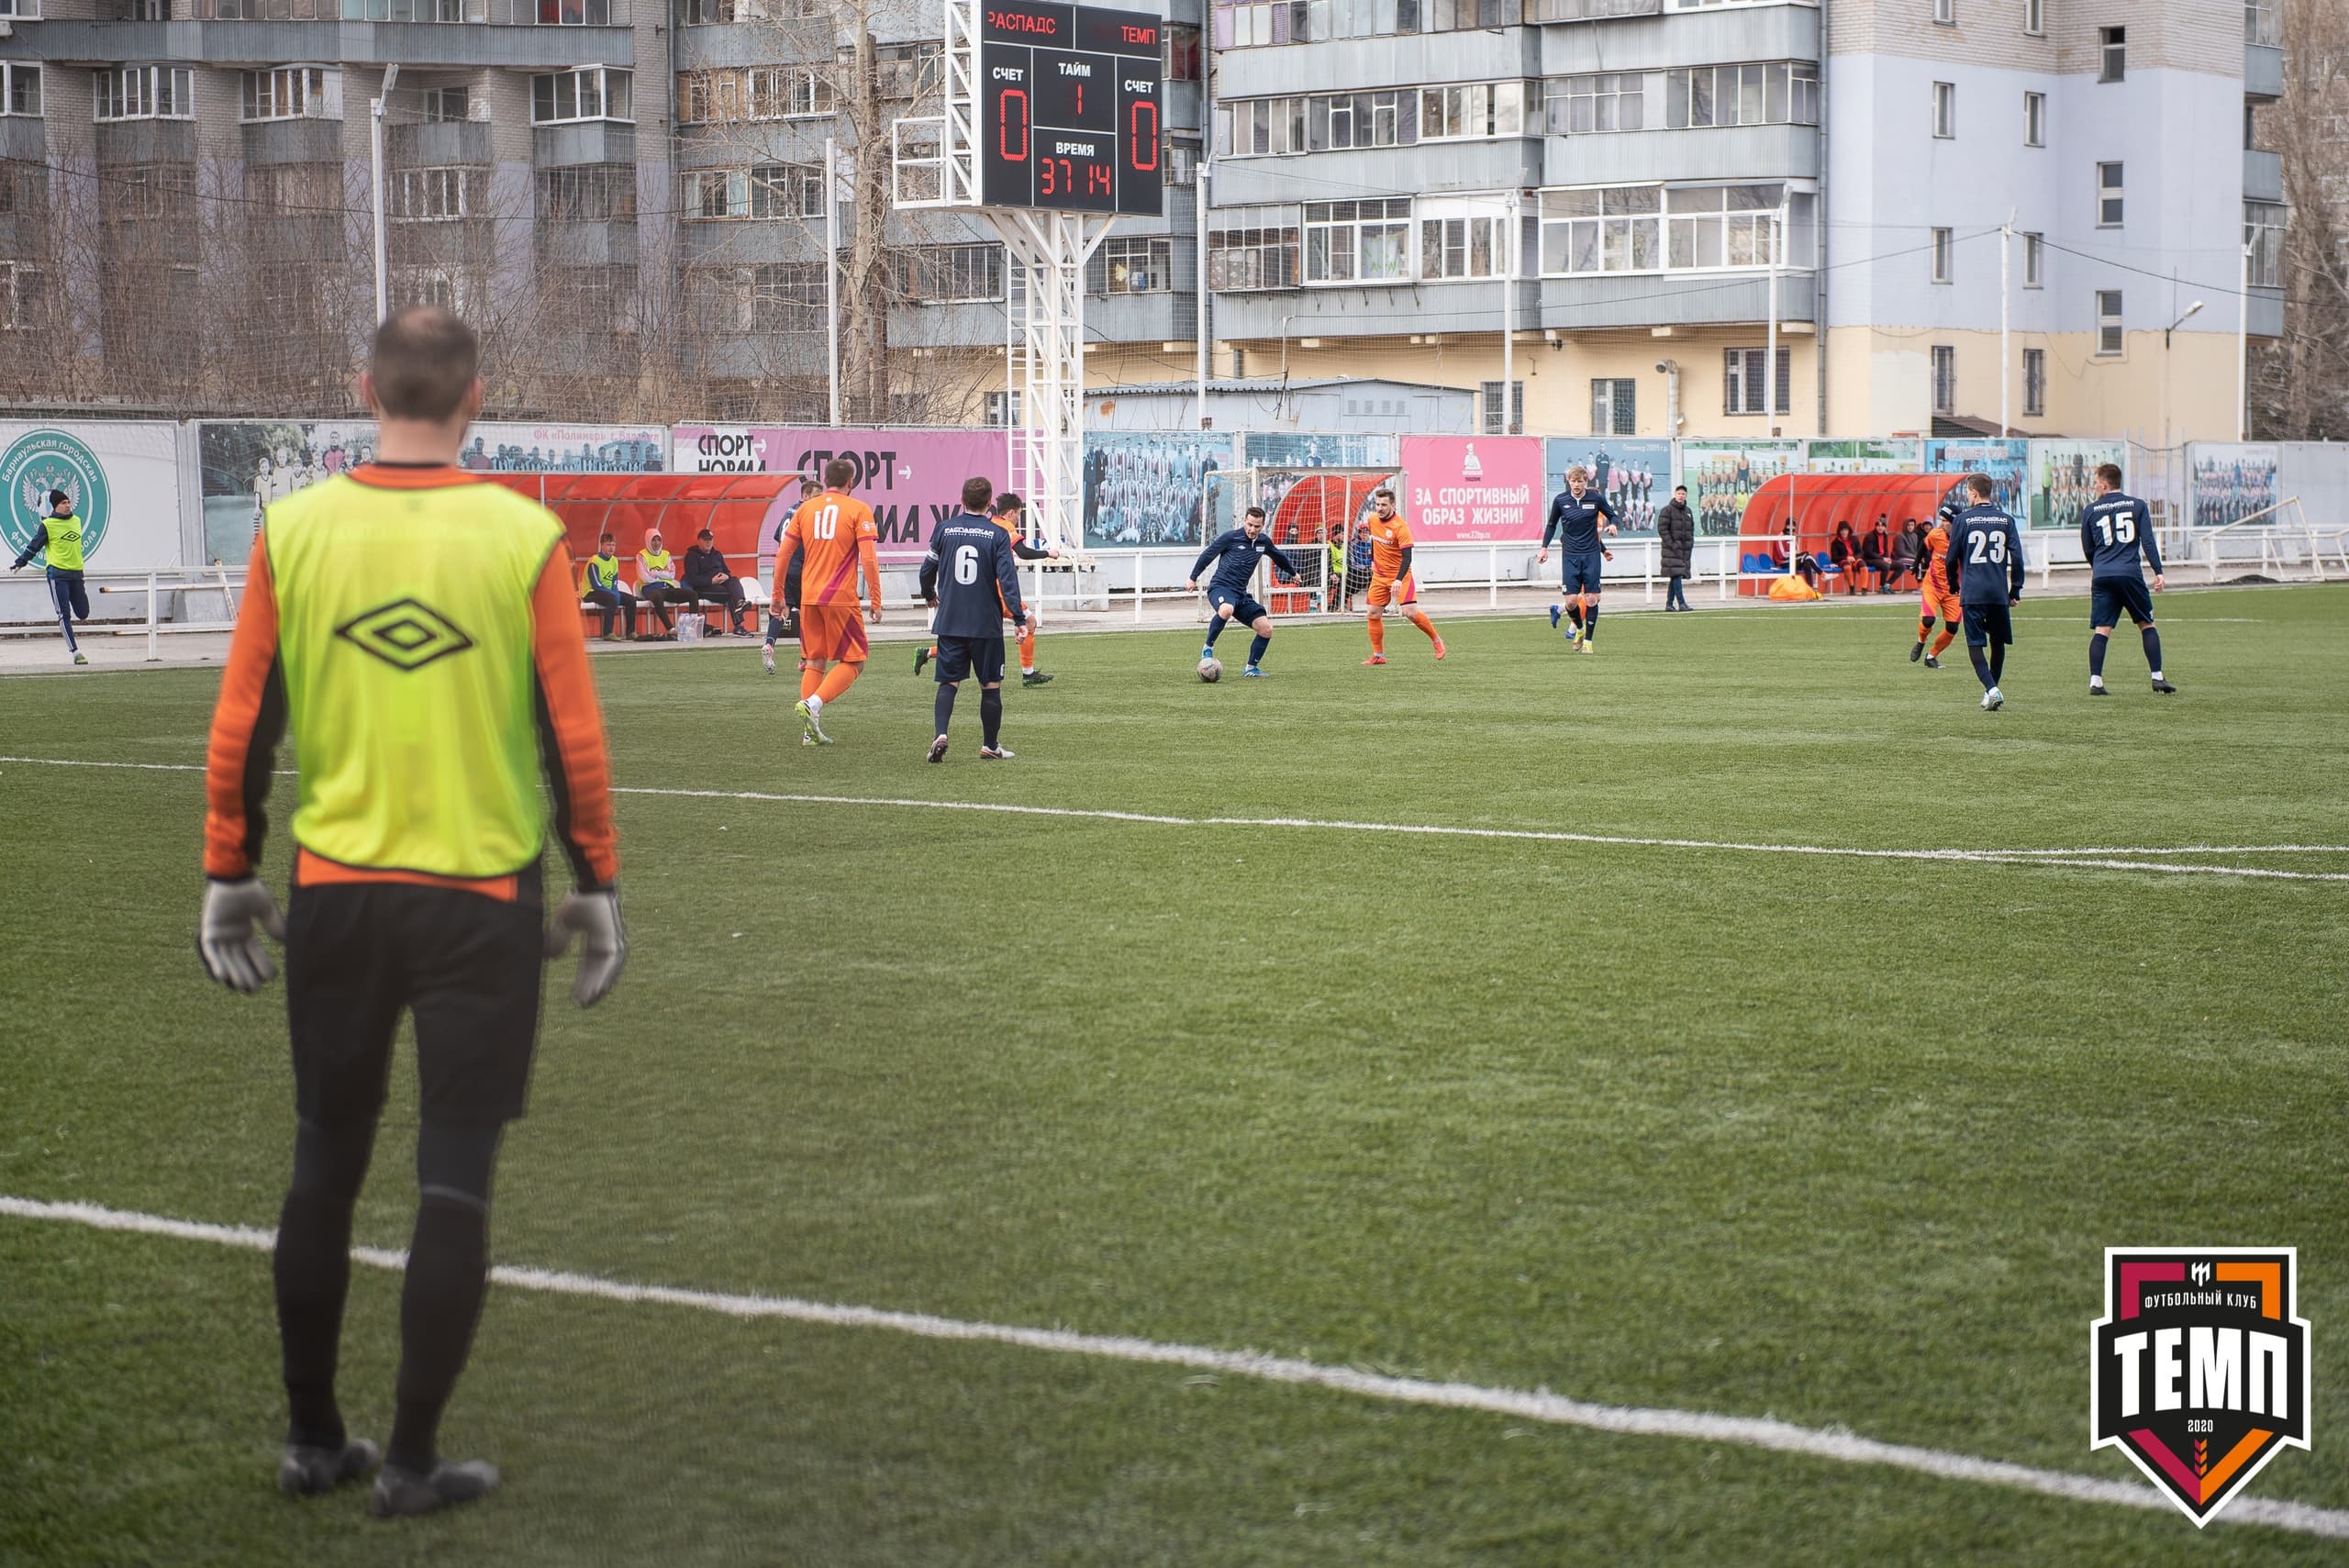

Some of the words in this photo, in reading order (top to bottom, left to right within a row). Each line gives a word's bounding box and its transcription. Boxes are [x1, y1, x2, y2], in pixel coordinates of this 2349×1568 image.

[1121, 26, 1156, 45] ТЕМП
[992, 67, 1024, 82] СЧЕТ
[1058, 61, 1091, 77] ТАЙМ
[1077, 83, 1083, 115] 1
[1124, 79, 1153, 94] СЧЕТ
[999, 89, 1028, 161] 0
[1131, 101, 1157, 172] 0
[1055, 141, 1095, 157] ВРЕМЯ
[2, 439, 57, 484] Барнаульская
[58, 441, 98, 484] городская
[698, 434, 754, 457] СПОРТ
[796, 450, 896, 491] СПОРТ
[1414, 487, 1432, 506] ЗА
[1439, 484, 1530, 506] СПОРТИВНЫЙ
[813, 504, 840, 540] 10
[1422, 507, 1464, 526] ОБРАЗ
[1471, 506, 1524, 525] ЖИЗНИ!
[2095, 511, 2135, 546] 15
[1968, 529, 2007, 564] 23
[954, 544, 979, 585] 6
